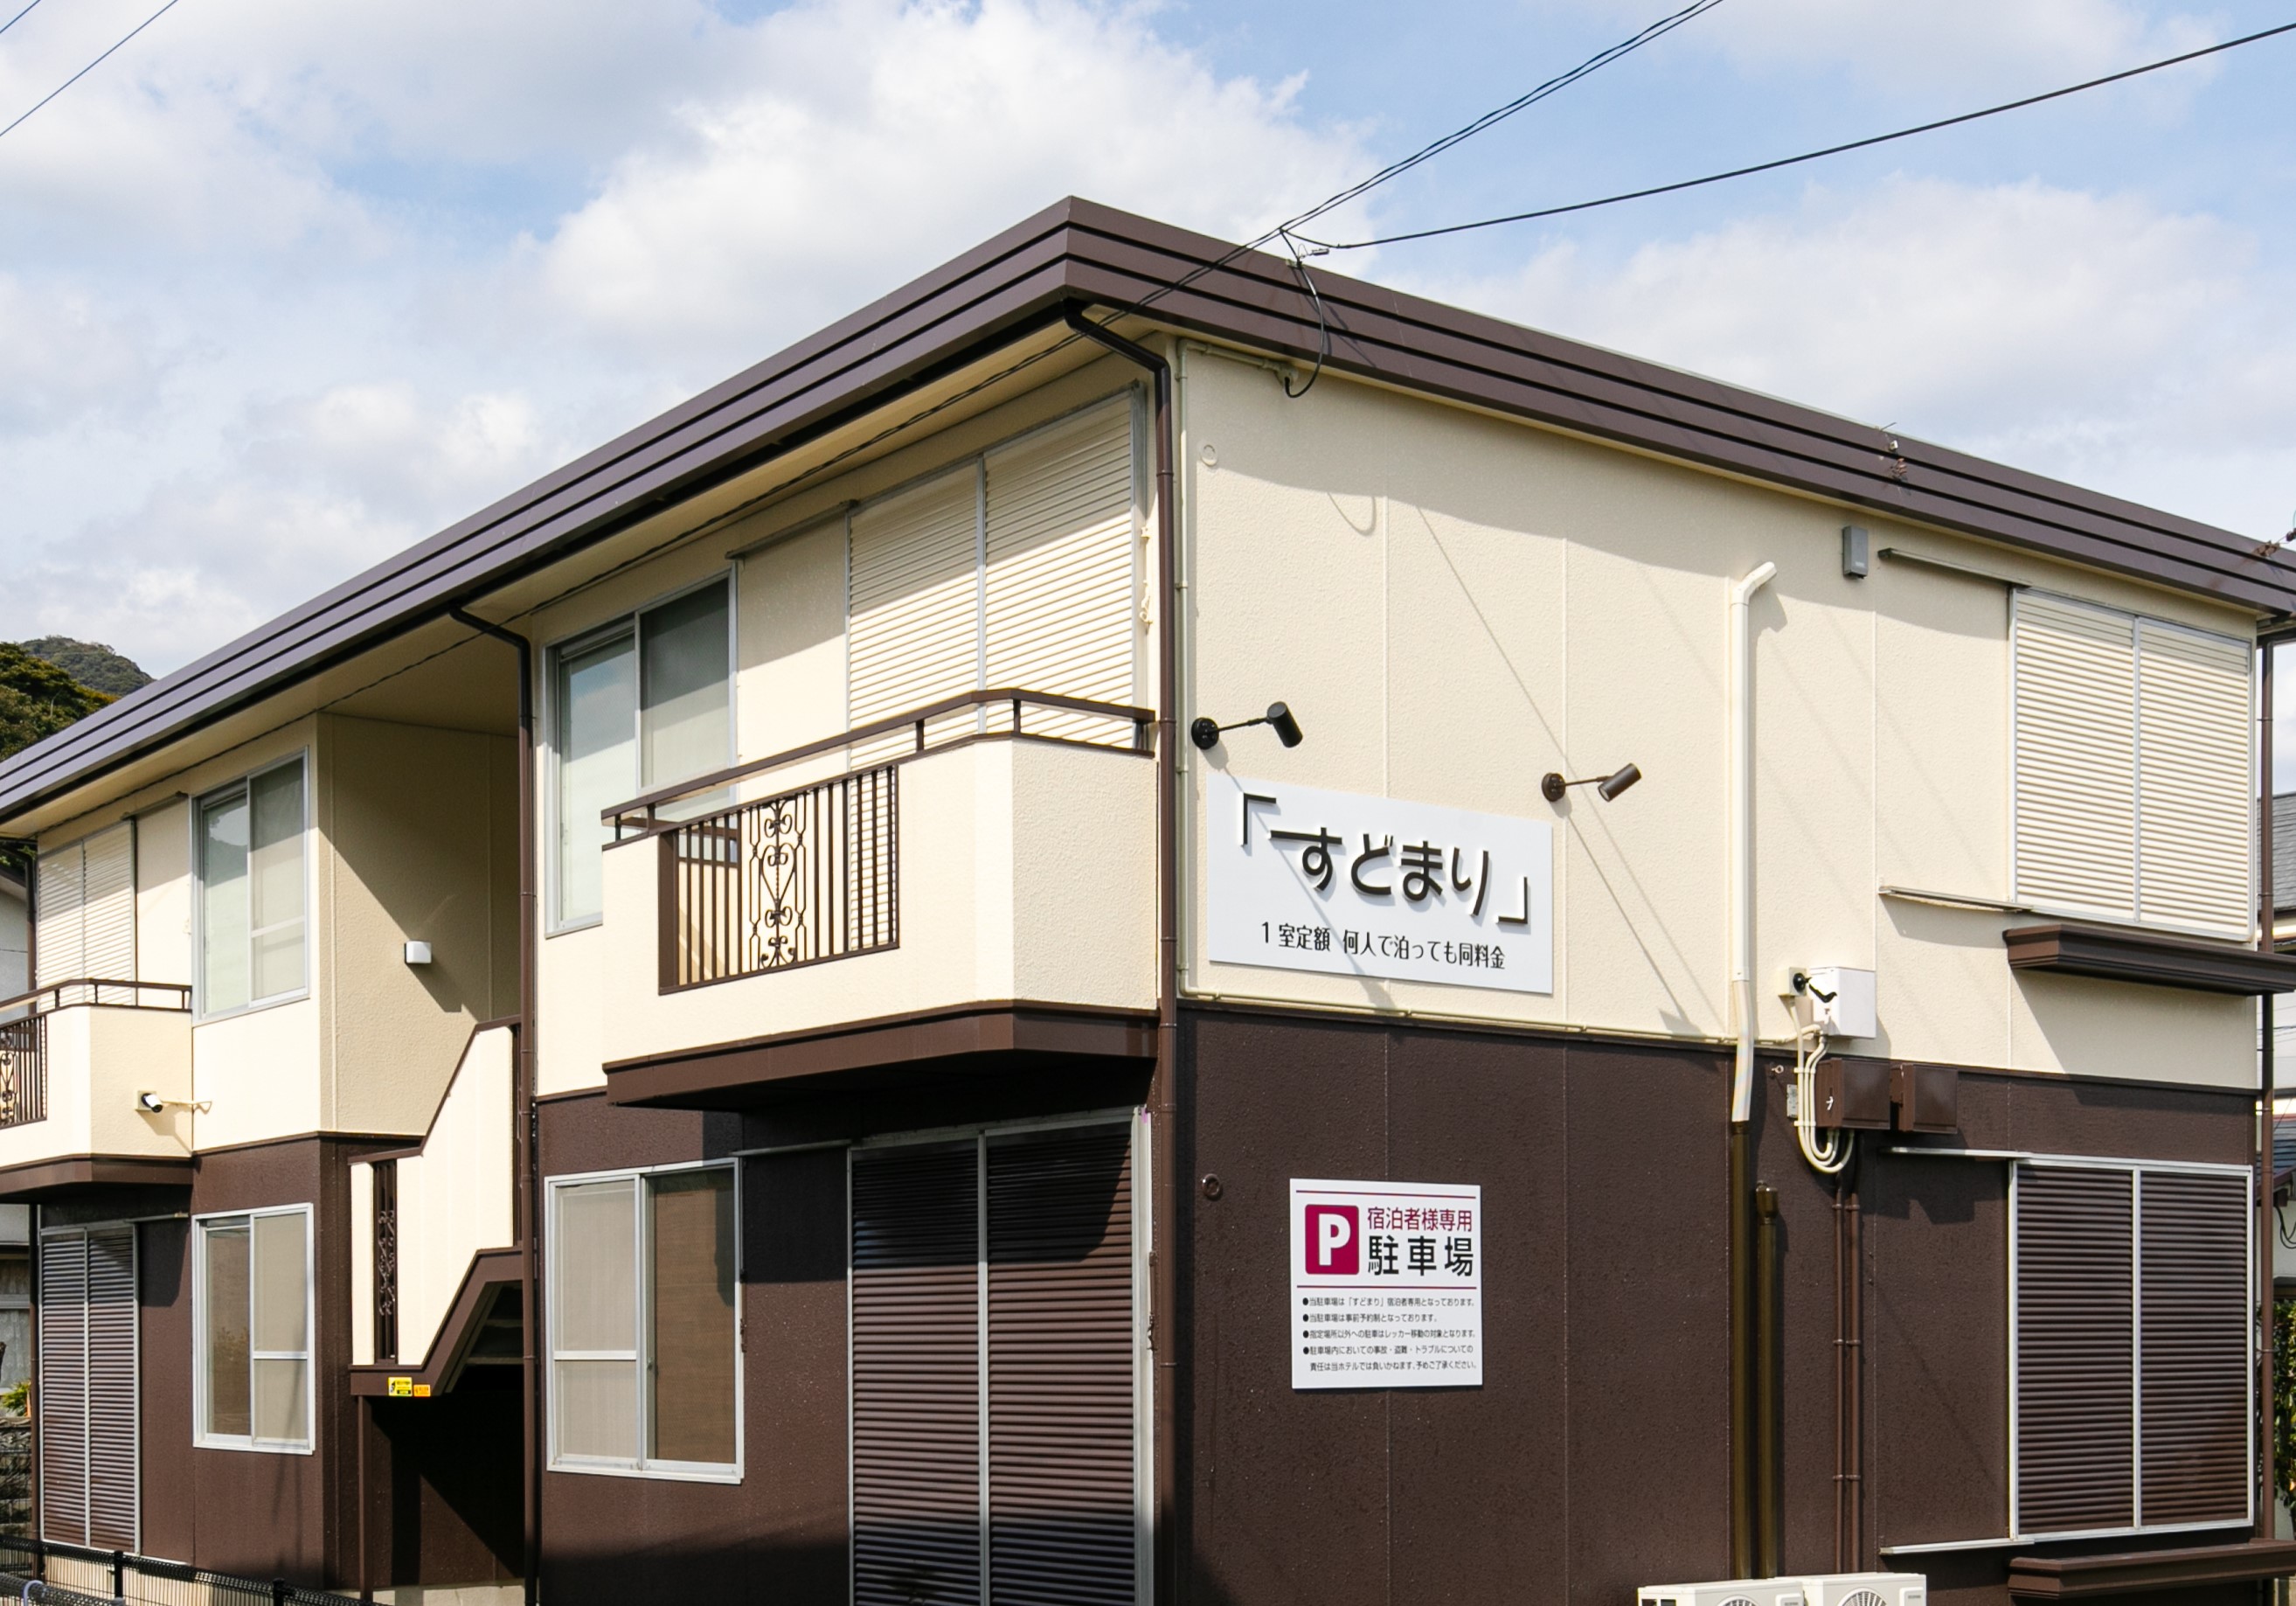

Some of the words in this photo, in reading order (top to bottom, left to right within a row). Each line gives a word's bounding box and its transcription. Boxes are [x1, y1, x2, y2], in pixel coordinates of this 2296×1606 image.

[1241, 792, 1529, 925] 「すどまり」
[1342, 928, 1506, 970] 何人で泊っても同料金
[1318, 1213, 1351, 1266] P
[1368, 1206, 1472, 1233] 宿泊者様専用
[1368, 1234, 1474, 1276] 駐車場
